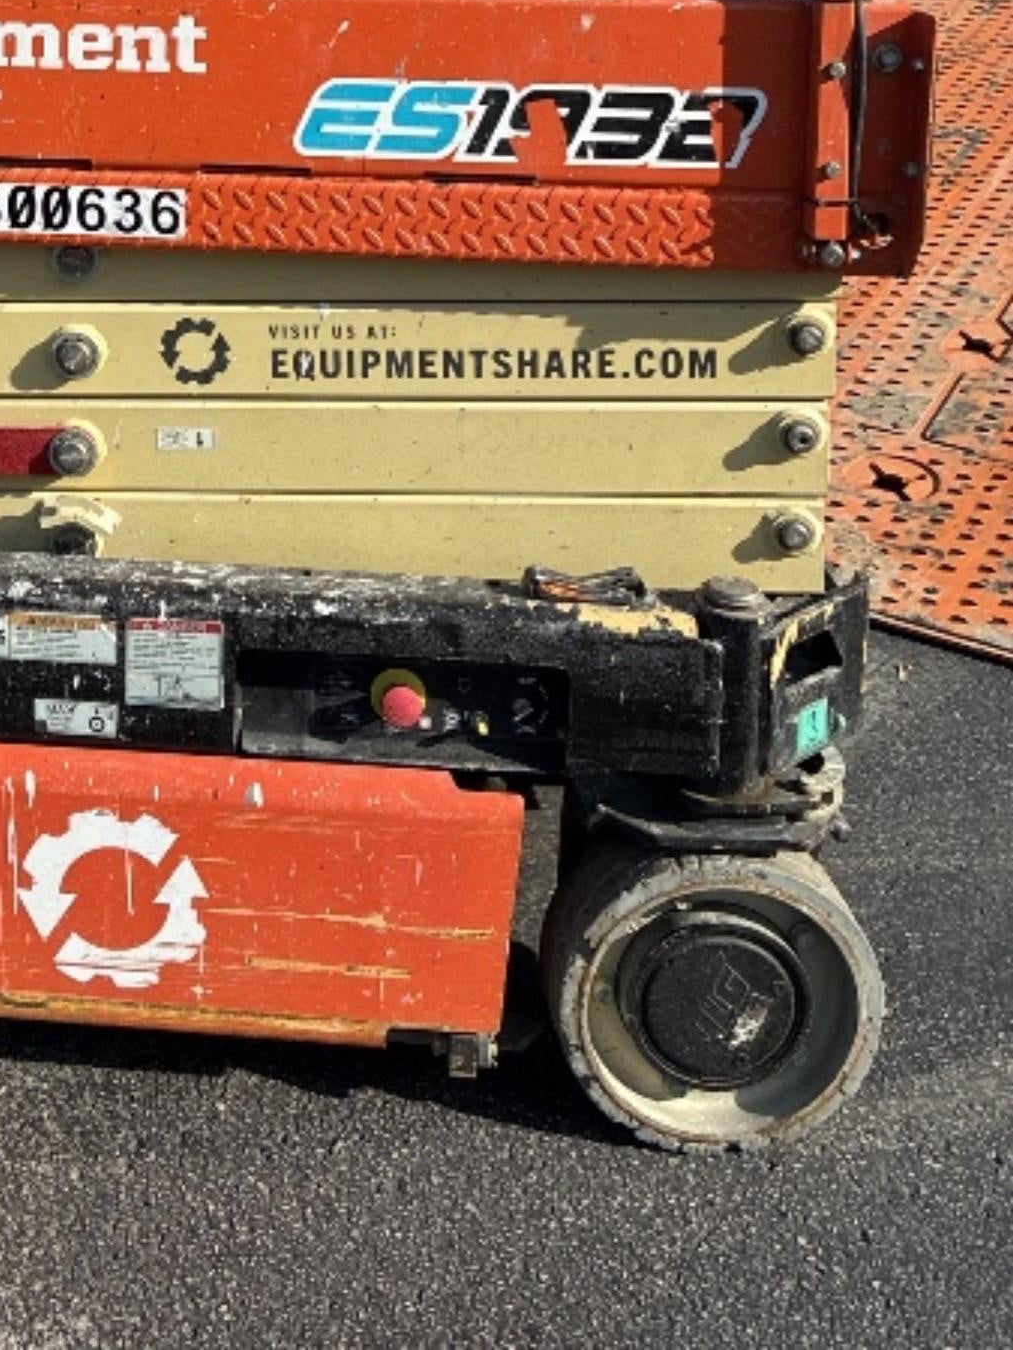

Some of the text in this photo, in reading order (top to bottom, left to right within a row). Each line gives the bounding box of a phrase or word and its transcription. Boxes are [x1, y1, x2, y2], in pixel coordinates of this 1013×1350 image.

[267, 324, 398, 340] VISIT US AT:
[270, 347, 719, 381] EQUIPMENTSHARE.COM
